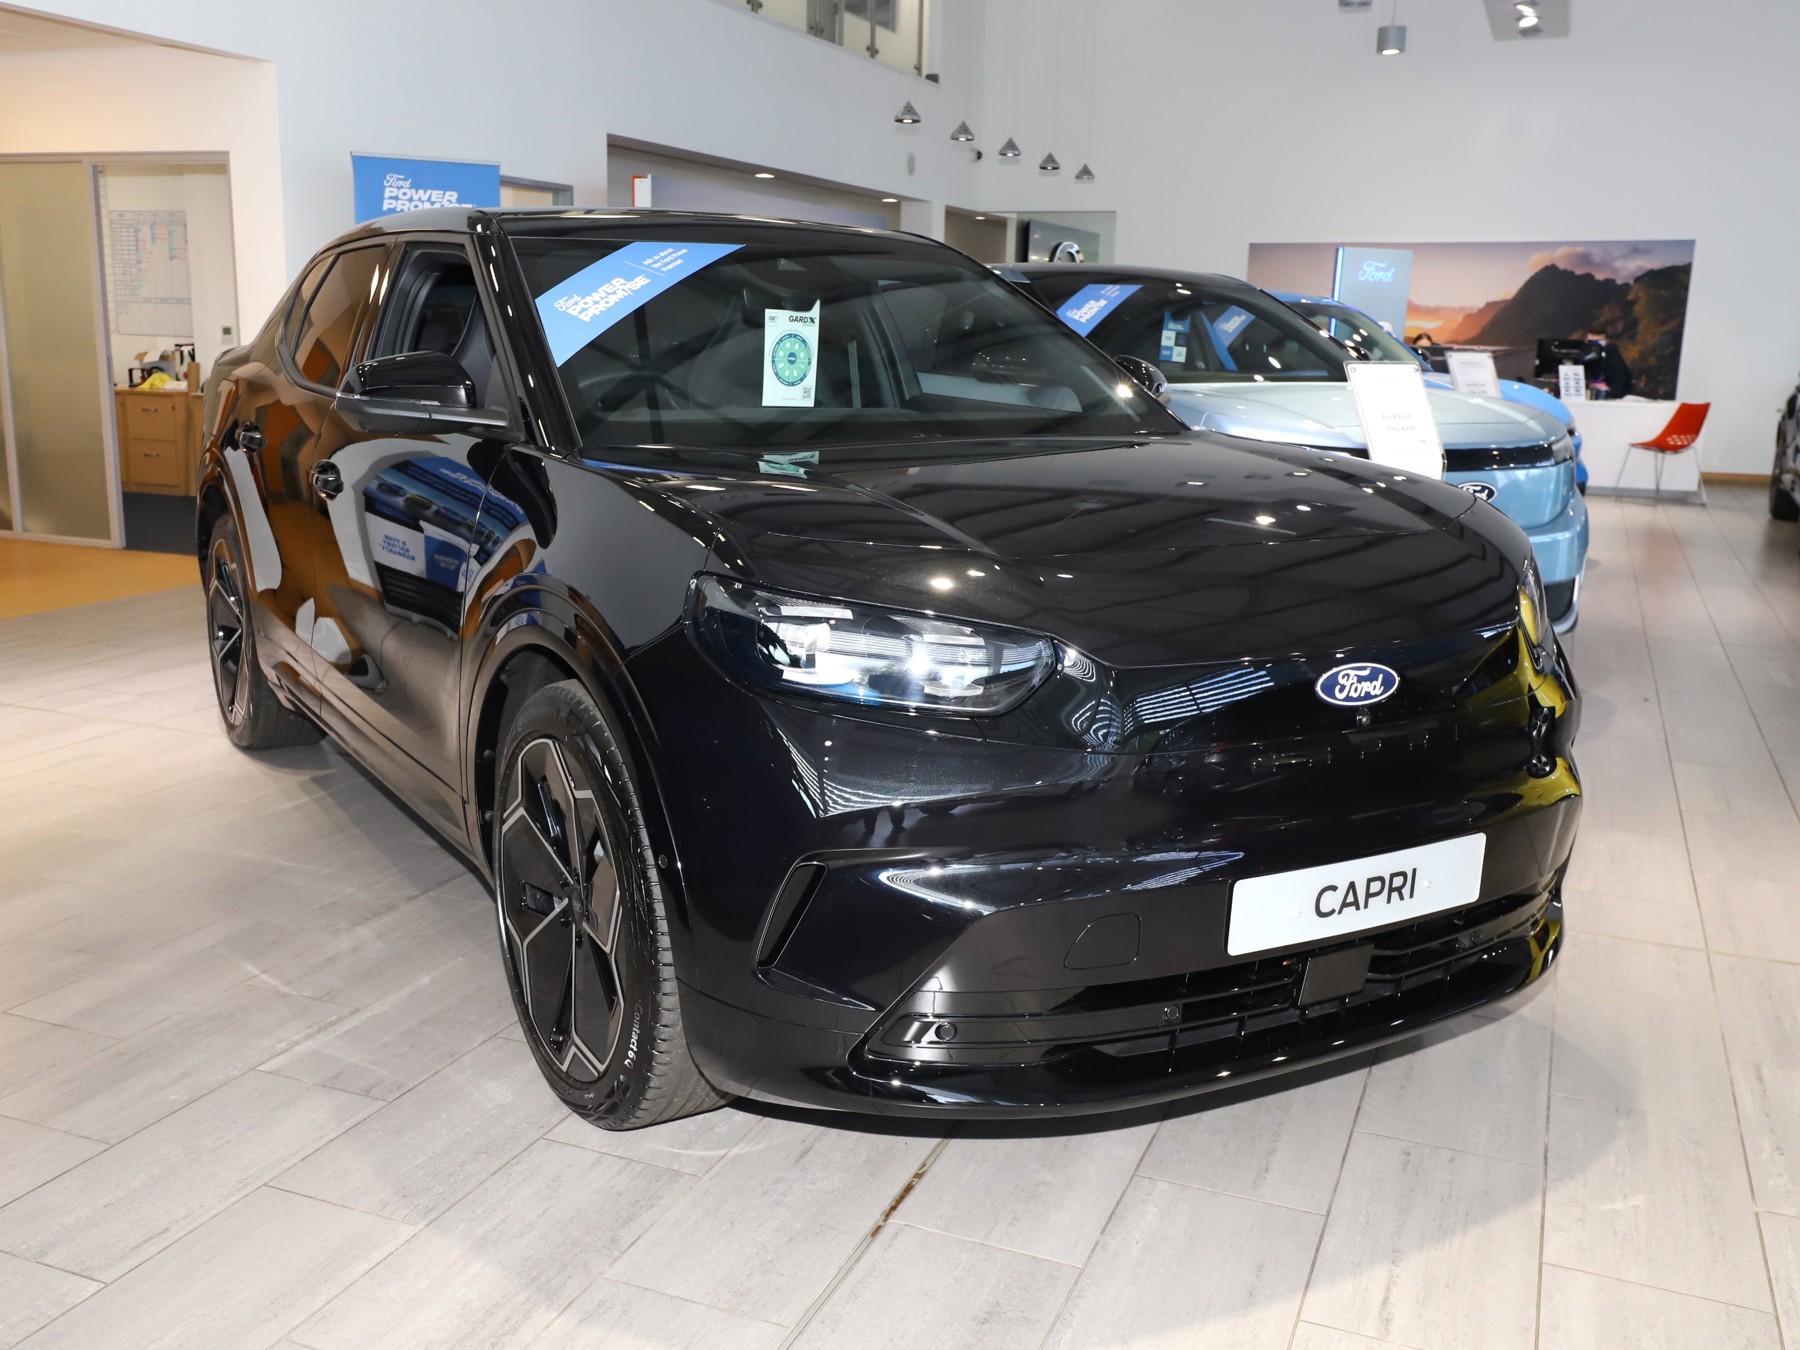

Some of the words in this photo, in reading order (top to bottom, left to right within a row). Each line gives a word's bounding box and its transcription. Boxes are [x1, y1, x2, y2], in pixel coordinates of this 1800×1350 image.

[383, 173, 412, 188] Ford
[384, 187, 458, 203] POWER
[1358, 260, 1395, 282] Ford
[554, 293, 581, 312] Ford
[566, 277, 628, 317] POWER
[577, 274, 651, 323] PROMISE
[788, 315, 817, 324] GARDX
[1335, 666, 1384, 699] Ford
[1314, 867, 1418, 919] CAPRI
